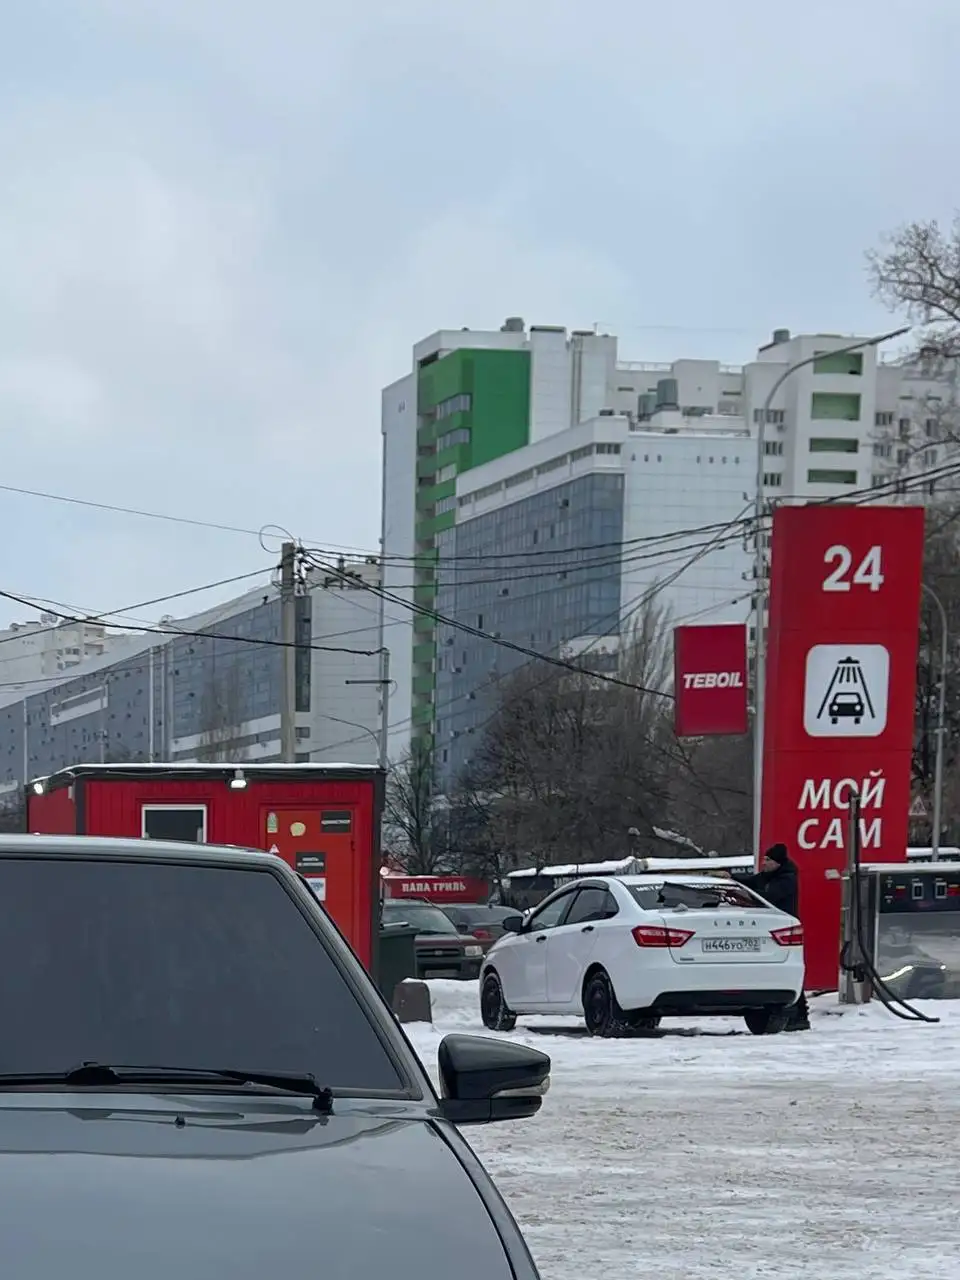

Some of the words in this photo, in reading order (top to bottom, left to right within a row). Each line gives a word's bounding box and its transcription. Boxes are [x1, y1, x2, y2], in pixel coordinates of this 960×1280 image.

[822, 544, 884, 592] 24
[683, 672, 744, 689] TEBOIL
[797, 768, 886, 810] МОЙ
[402, 882, 431, 892] ПАПА
[433, 881, 467, 892] ГРИЛЬ
